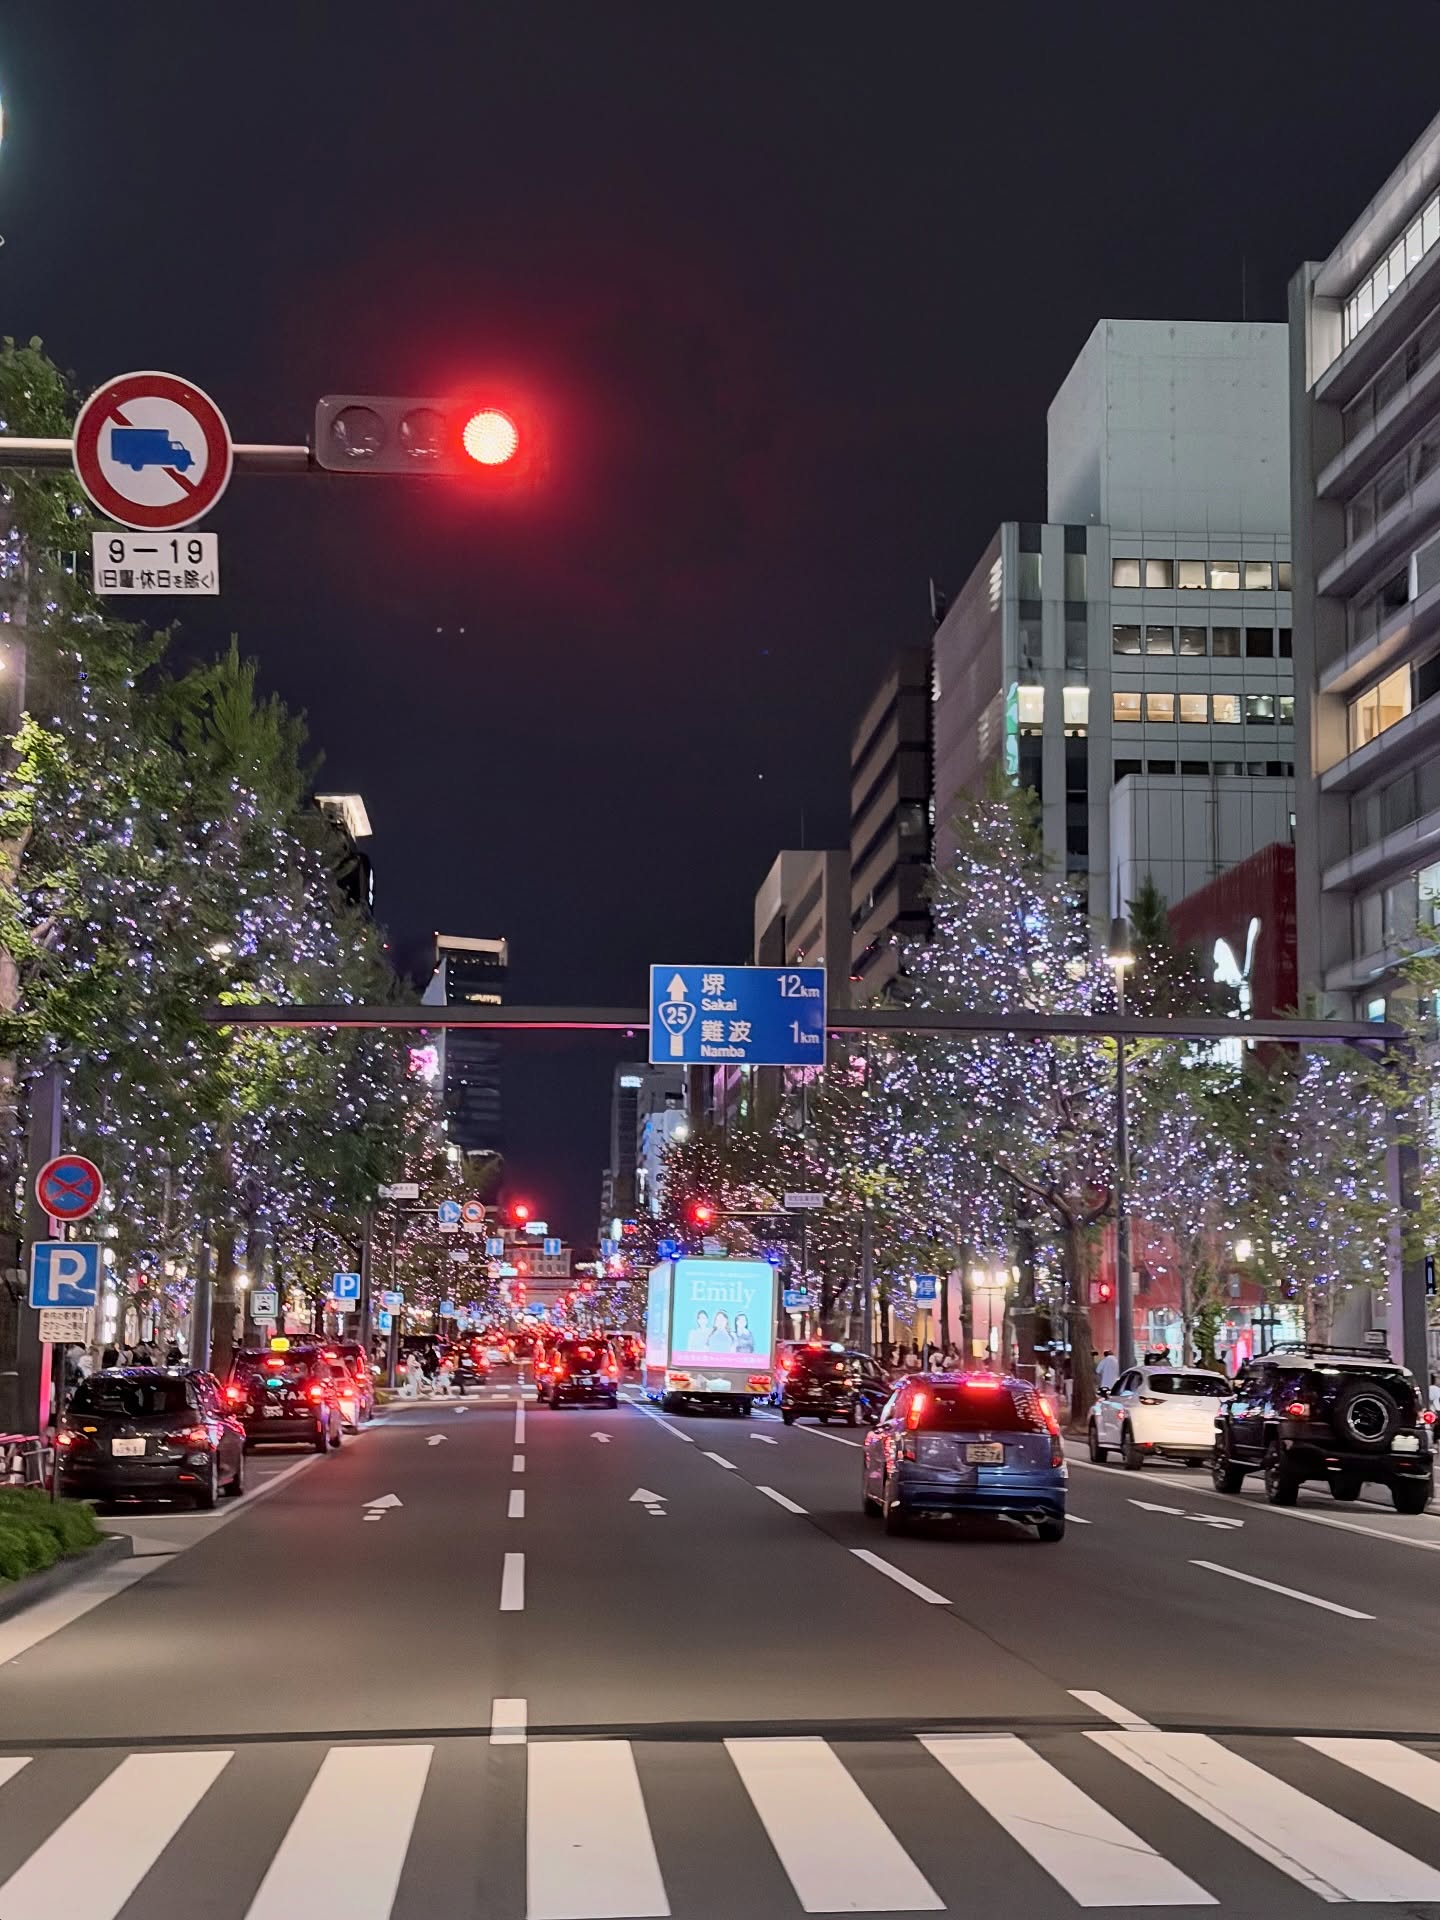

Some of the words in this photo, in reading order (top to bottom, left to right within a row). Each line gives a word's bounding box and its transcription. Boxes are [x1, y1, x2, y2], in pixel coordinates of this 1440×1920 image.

[701, 973, 726, 996] 堺
[666, 1006, 688, 1025] 25
[701, 998, 737, 1011] Sakai
[701, 1020, 752, 1043] 難波
[700, 1045, 746, 1058] Namba
[48, 1249, 87, 1301] P
[340, 1276, 356, 1297] P
[690, 1279, 757, 1309] Emily
